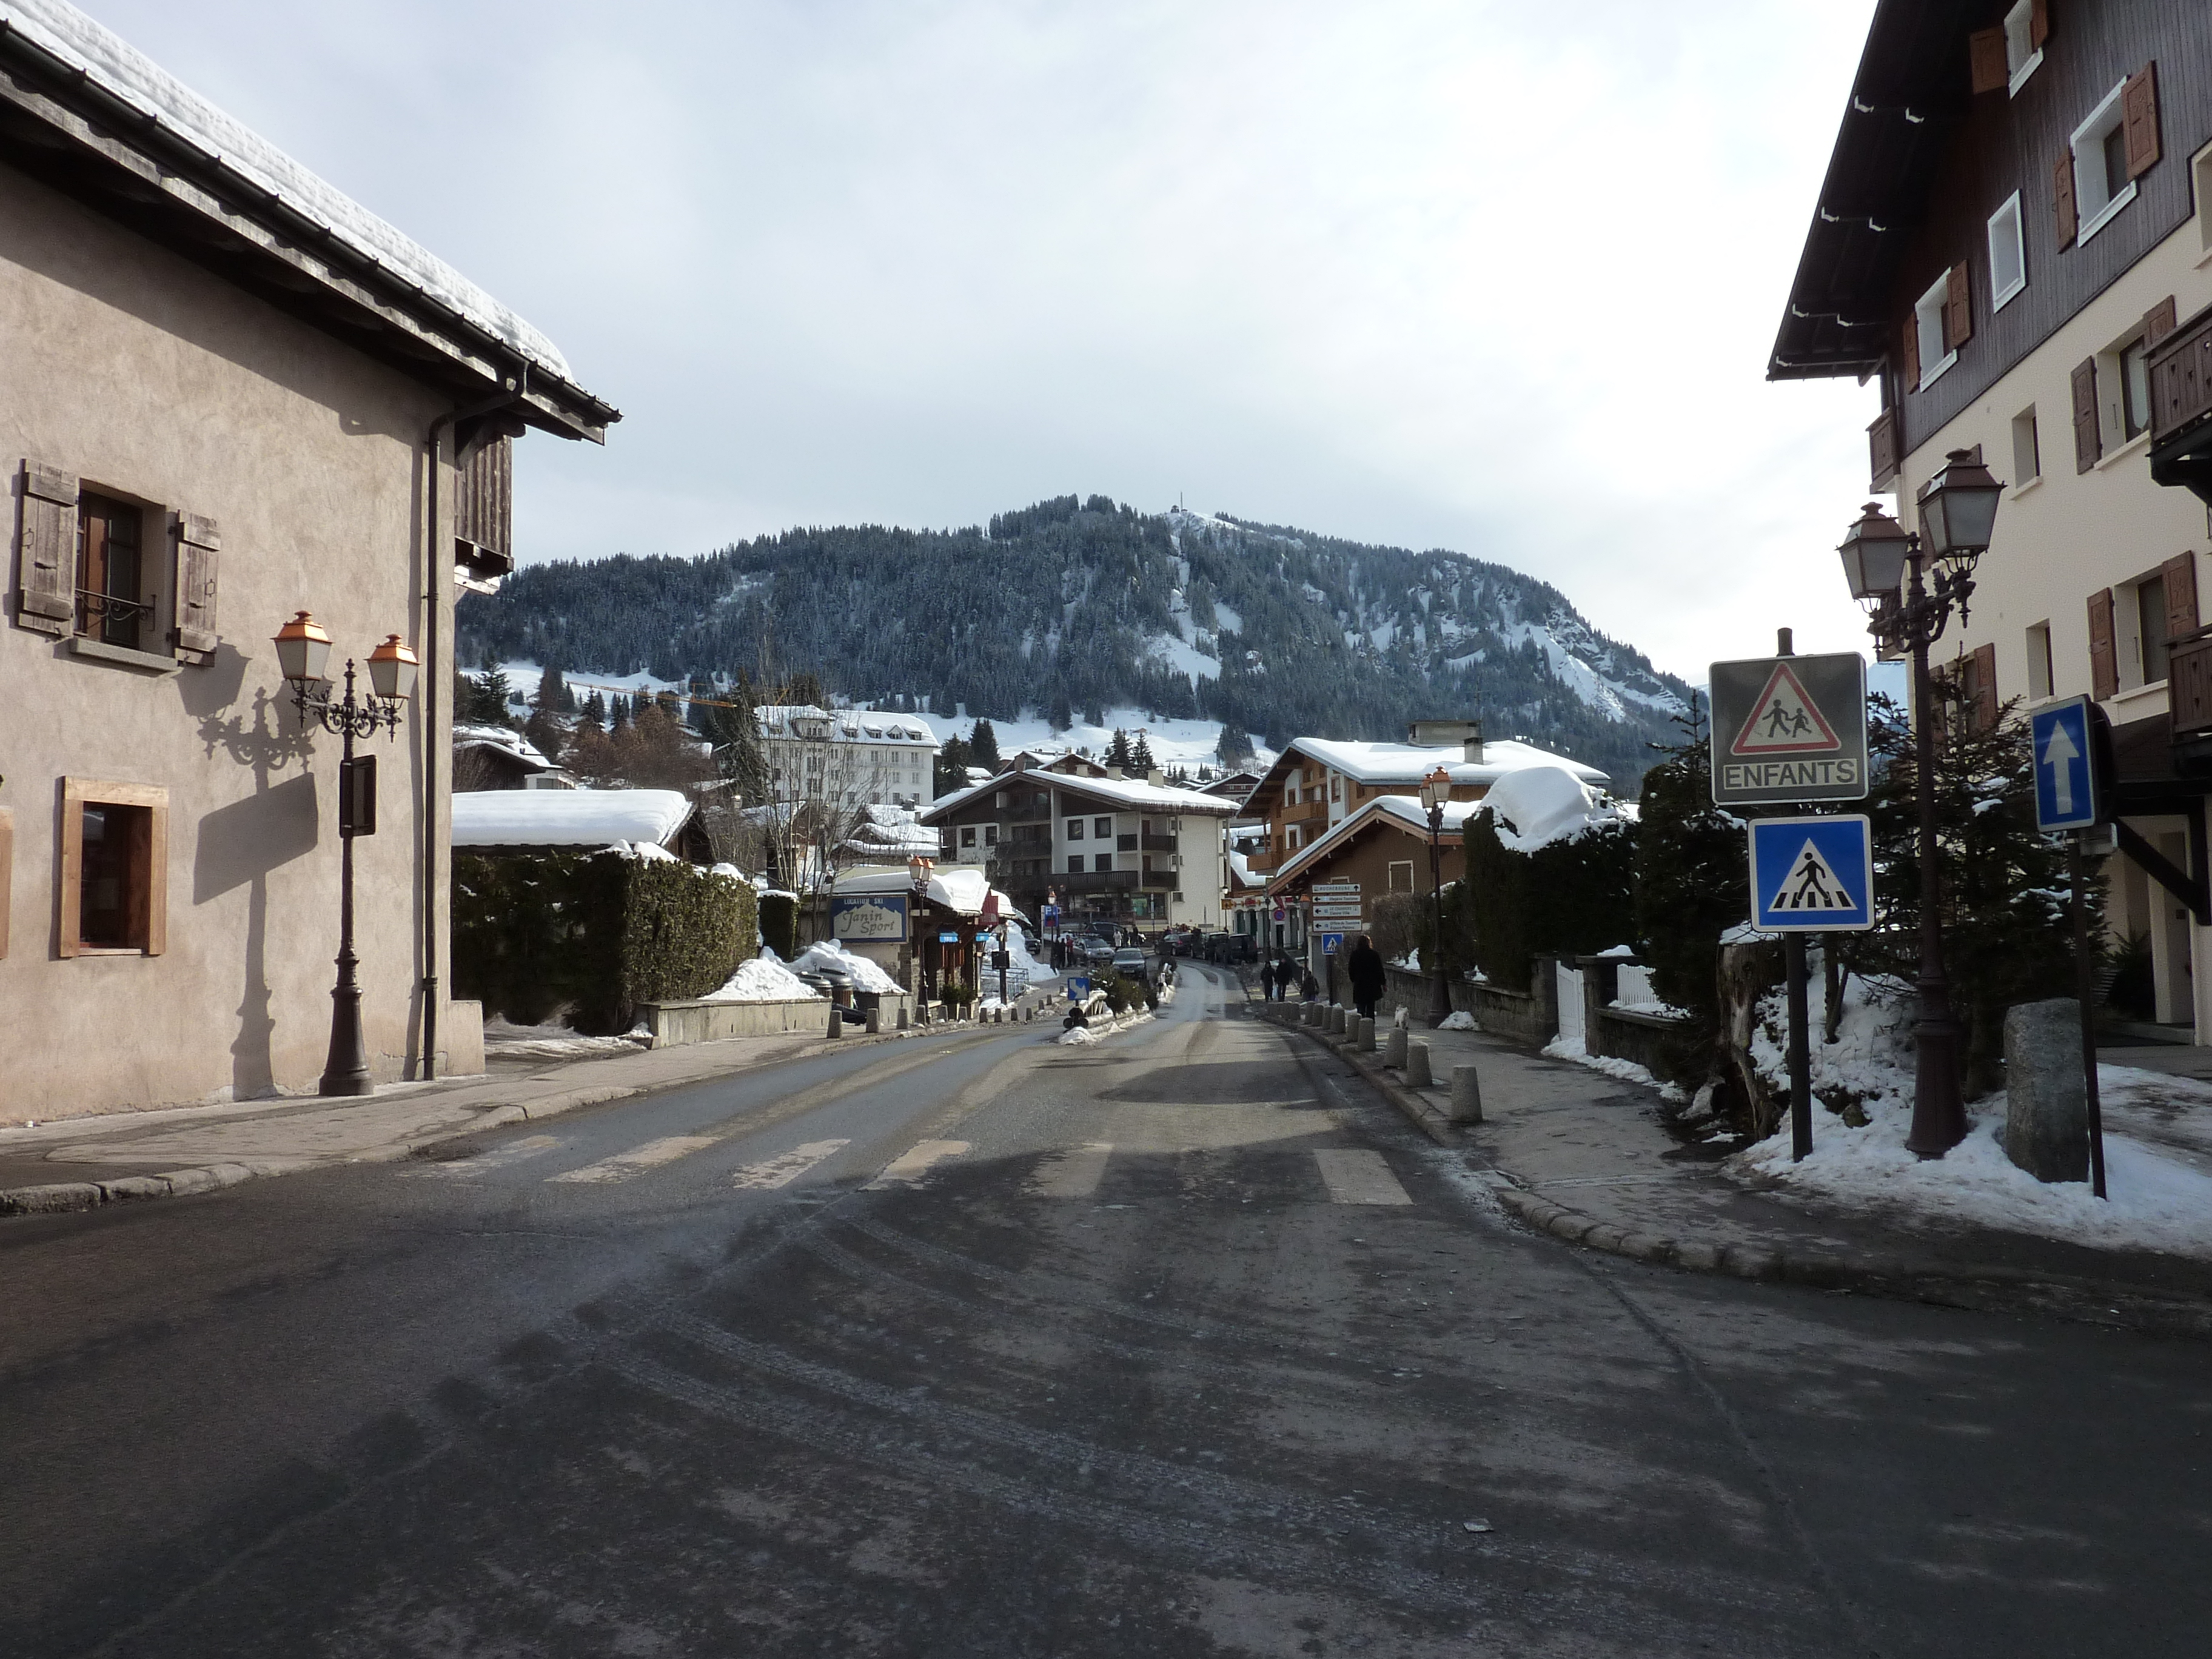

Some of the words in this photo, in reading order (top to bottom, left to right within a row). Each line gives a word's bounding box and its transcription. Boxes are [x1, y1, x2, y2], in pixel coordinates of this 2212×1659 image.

[1725, 760, 1855, 788] ENFANTS
[841, 910, 883, 932] Janin
[860, 921, 894, 936] Sport
